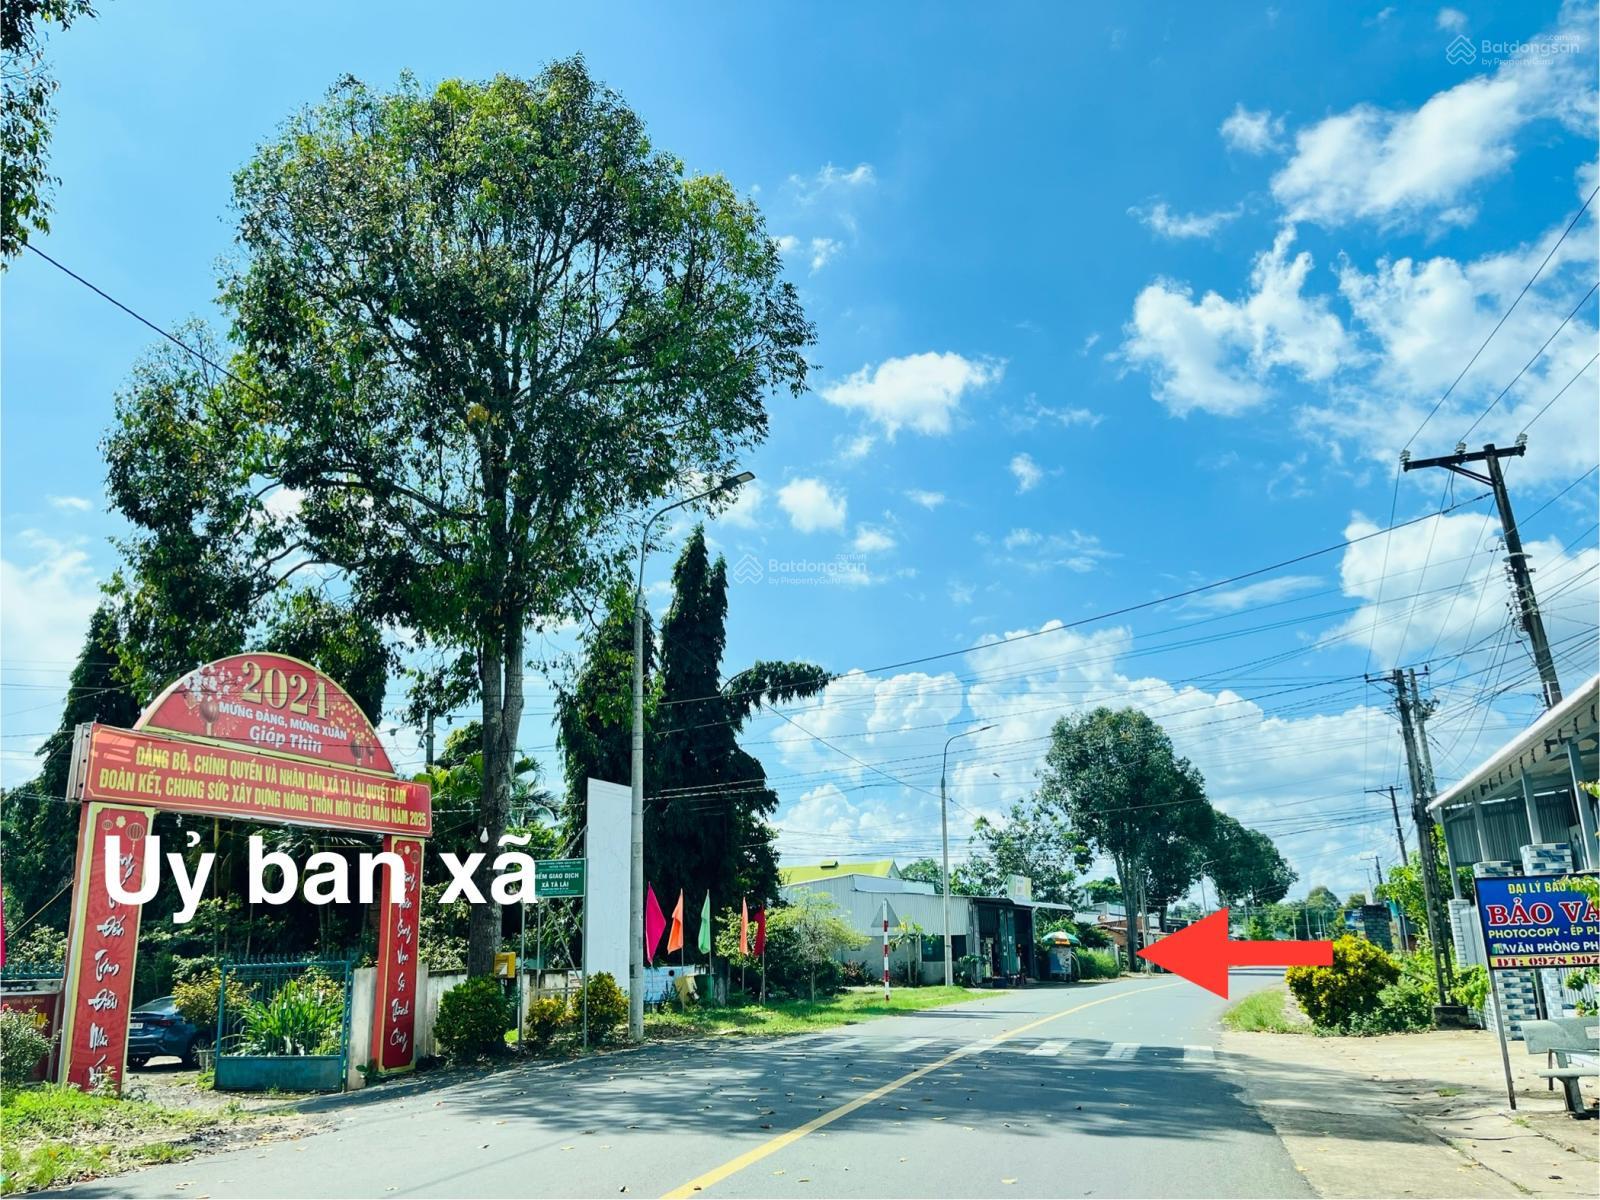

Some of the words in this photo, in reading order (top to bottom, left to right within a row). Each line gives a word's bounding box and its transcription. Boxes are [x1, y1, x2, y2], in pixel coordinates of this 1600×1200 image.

[242, 661, 330, 720] 2024
[219, 701, 253, 719] MỪNG
[256, 709, 288, 728] ĐẢNG,
[290, 717, 320, 735] MỪNG
[322, 725, 347, 741] XUÂN
[249, 725, 285, 748] Giáp
[290, 735, 322, 753] Thìn
[136, 742, 170, 769] ĐẢNG
[172, 749, 191, 776] BỘ,
[194, 753, 227, 777] CHÍNH
[265, 765, 277, 784] VÀ
[280, 767, 306, 790] NHÂN
[307, 771, 326, 793] DÂN
[340, 777, 351, 796] TÀ
[366, 782, 389, 802] QUYẾT
[390, 786, 408, 804] TÂM
[100, 766, 136, 792] ĐOÀN
[138, 769, 162, 797] KẾT,
[165, 776, 205, 800] CHUNG
[207, 778, 229, 802] SỨC
[231, 782, 252, 804] XÂY
[254, 786, 281, 811] DỰNG
[283, 789, 309, 812] NÔNG
[311, 793, 334, 816] THÔN
[335, 796, 352, 817] MỚI
[391, 805, 409, 825] NĂM
[409, 811, 427, 828] 2025
[564, 872, 580, 881] DỊCH
[1508, 883, 1527, 896] ĐẠI
[1529, 880, 1541, 894] LÝ
[1486, 897, 1554, 926] BẢO
[1488, 927, 1560, 939] PHOTOCOPY
[1570, 924, 1583, 936] ÉP
[1507, 941, 1535, 953] VĂN
[1537, 940, 1580, 954] PHÒNG
[1583, 941, 1598, 951] PH
[1528, 956, 1567, 966] 0978
[1571, 954, 1599, 964] 907
